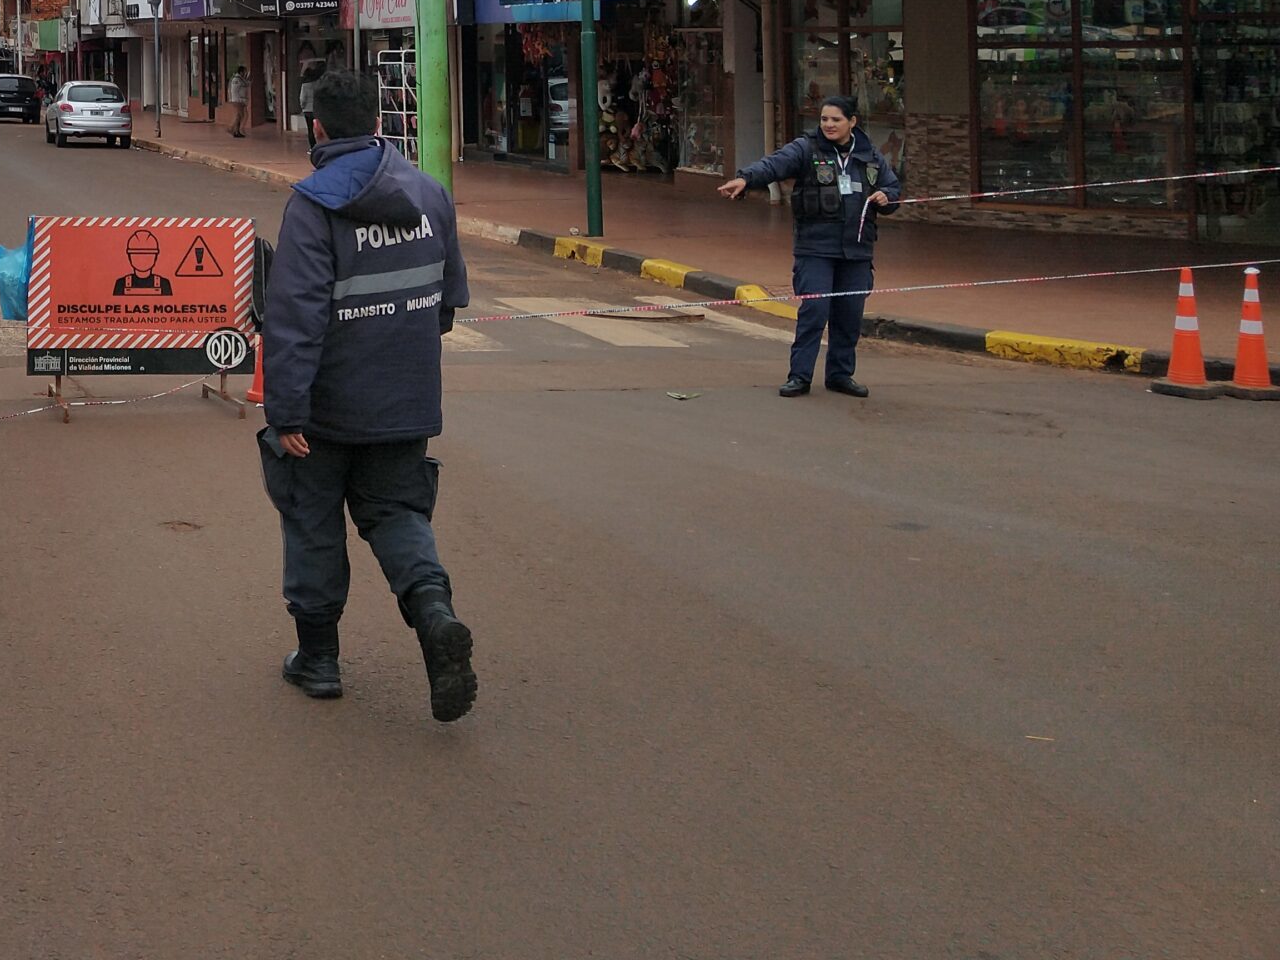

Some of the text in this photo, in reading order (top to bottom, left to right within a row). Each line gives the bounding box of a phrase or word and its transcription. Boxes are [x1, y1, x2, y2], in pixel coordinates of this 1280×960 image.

[355, 214, 434, 252] POLICIA
[57, 304, 227, 314] DISCULPE LAS MOLESTIAS
[337, 303, 396, 321] TRANSITO
[57, 316, 227, 324] ESTAMOS TRABAJANDO PARA USTED
